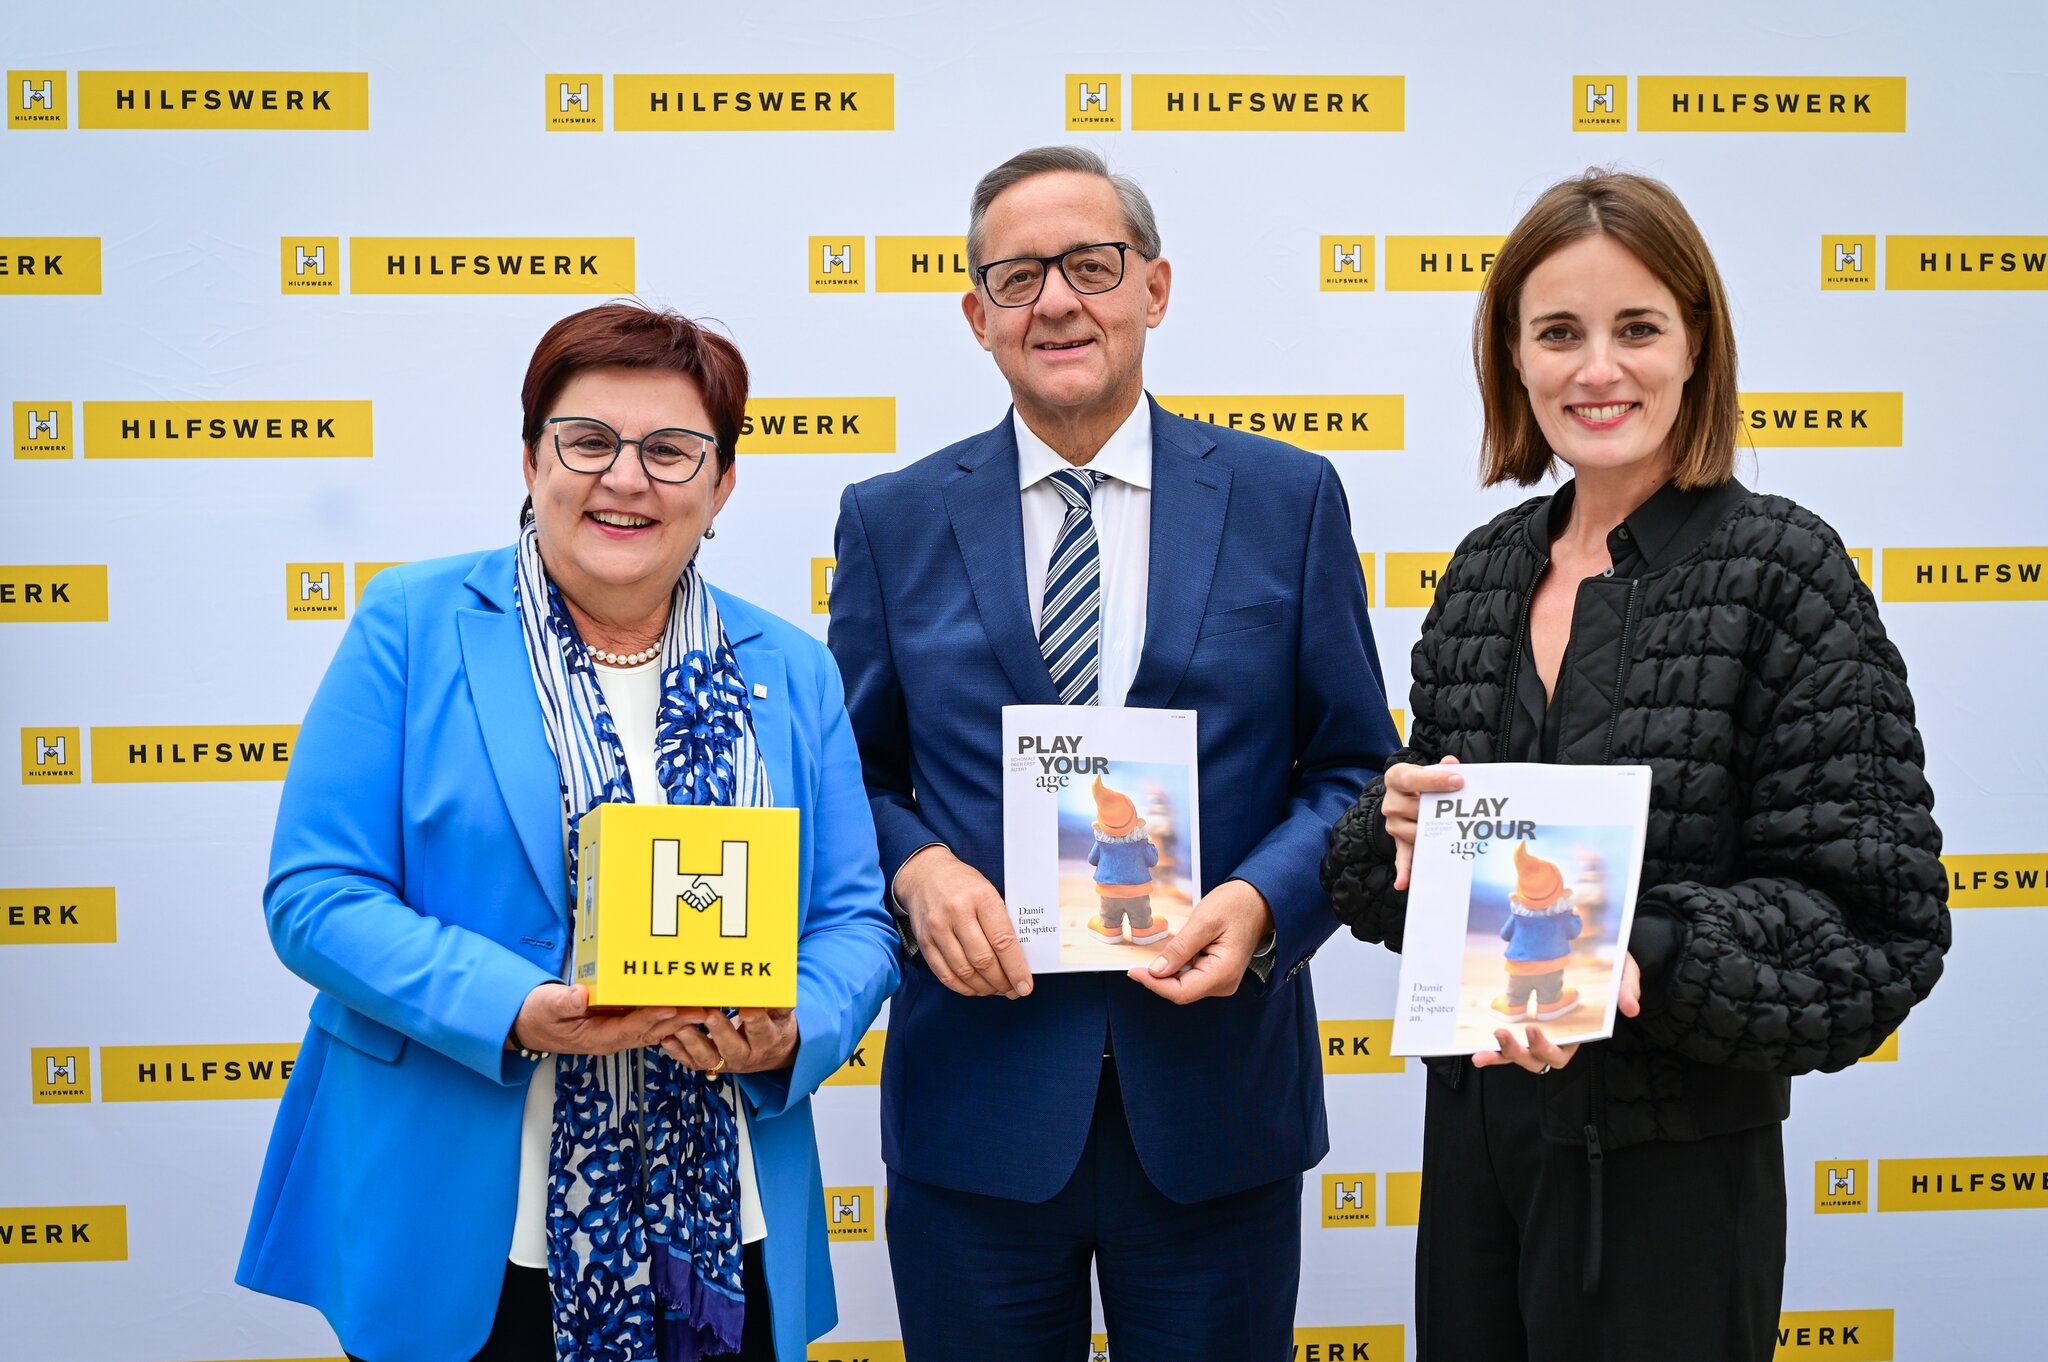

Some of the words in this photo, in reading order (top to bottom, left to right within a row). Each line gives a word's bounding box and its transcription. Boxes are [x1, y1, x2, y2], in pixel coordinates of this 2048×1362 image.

[116, 89, 331, 111] HILFSWERK
[650, 91, 858, 112] HILFSWERK
[1167, 92, 1370, 113] HILFSWERK
[1672, 93, 1871, 114] HILFSWERK
[387, 255, 598, 276] HILFSWERK
[1921, 252, 2047, 272] HILFSW
[121, 418, 336, 440] HILFSWERK
[1179, 413, 1369, 432] FSWERK
[1738, 410, 1868, 429] SWERK
[1917, 563, 2042, 584] HILFSW
[1018, 735, 1083, 755] PLAY
[1038, 756, 1110, 775] YOUR
[1036, 775, 1070, 793] age
[1435, 797, 1510, 819] PLAY
[1456, 820, 1536, 840] YOUR
[1450, 841, 1489, 861] age
[1955, 870, 2048, 890] LFSW
[0, 905, 79, 926] ERK
[1019, 906, 1044, 915] Damit
[1019, 917, 1040, 926] fange
[1019, 926, 1031, 934] ich
[1032, 926, 1057, 935] später
[623, 960, 772, 977] HILFSWERK
[1413, 983, 1443, 992] Damit
[1410, 1004, 1424, 1012] ich
[1293, 1343, 1370, 1362] ERK
